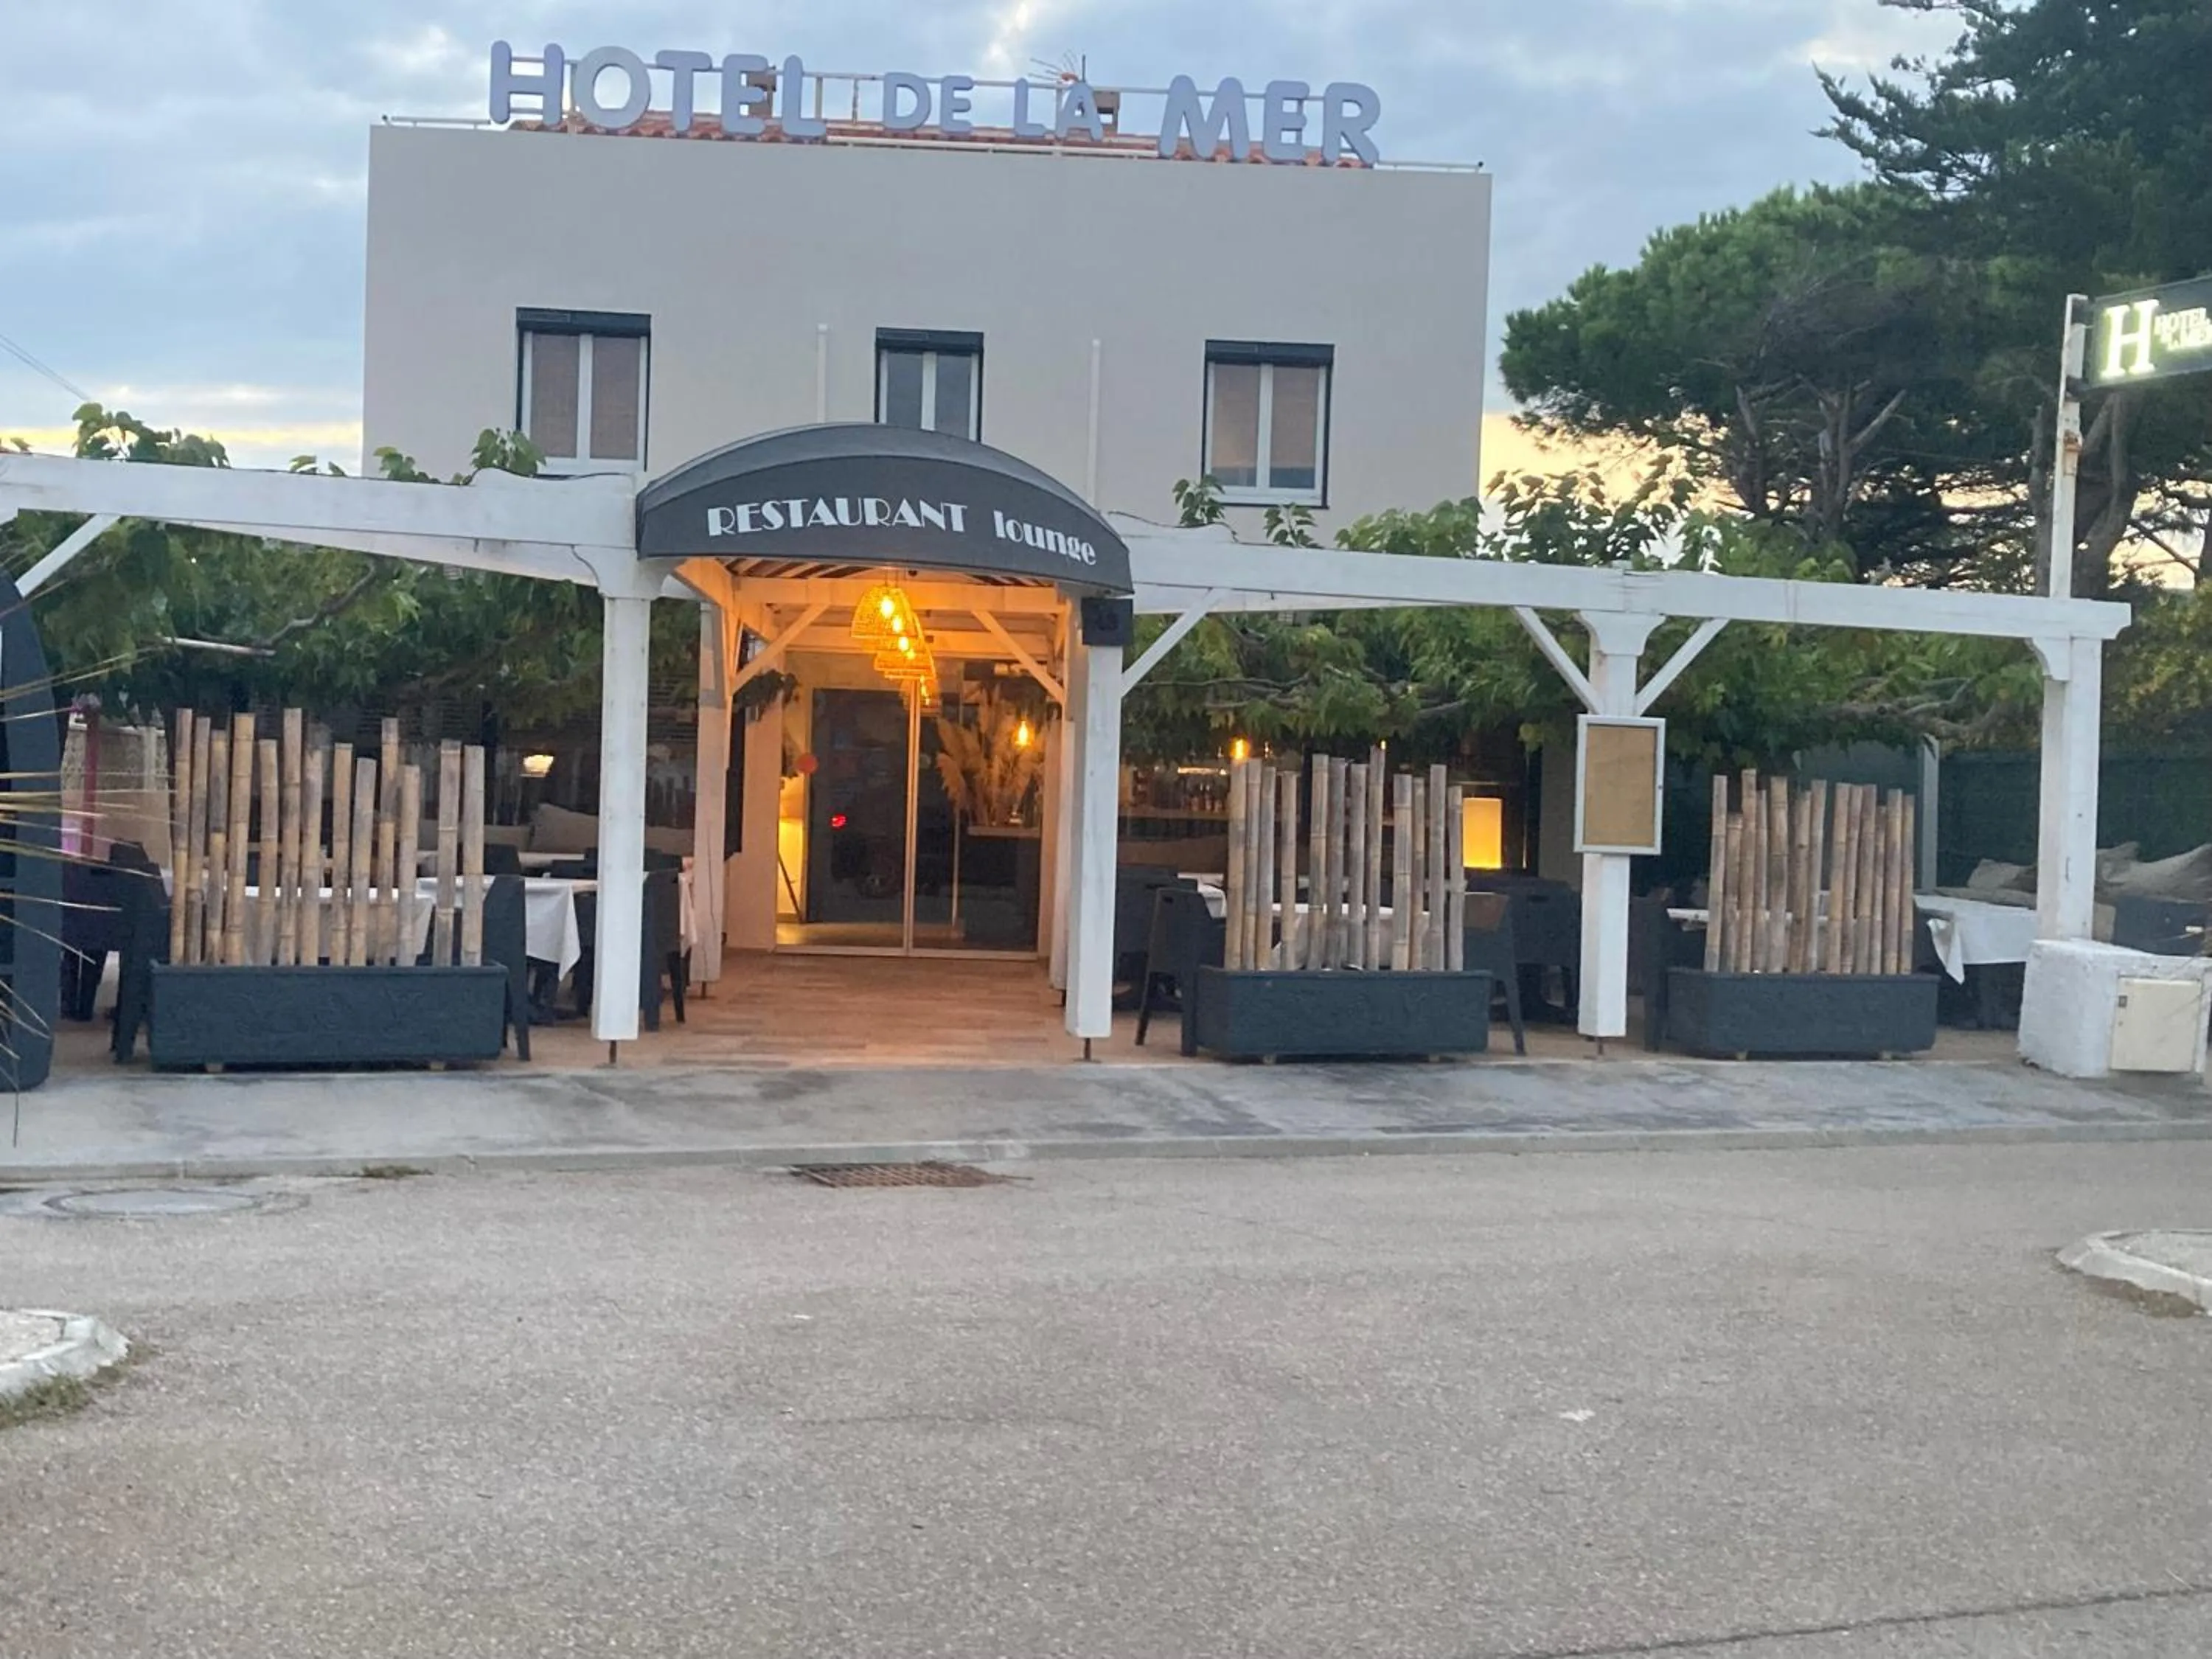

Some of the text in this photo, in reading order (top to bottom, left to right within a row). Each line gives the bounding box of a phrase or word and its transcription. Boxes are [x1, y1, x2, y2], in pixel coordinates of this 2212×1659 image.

[490, 40, 1380, 167] HOTEL DE LA MER
[2100, 299, 2160, 378] H
[707, 498, 1097, 566] RESTAURANT lounge
